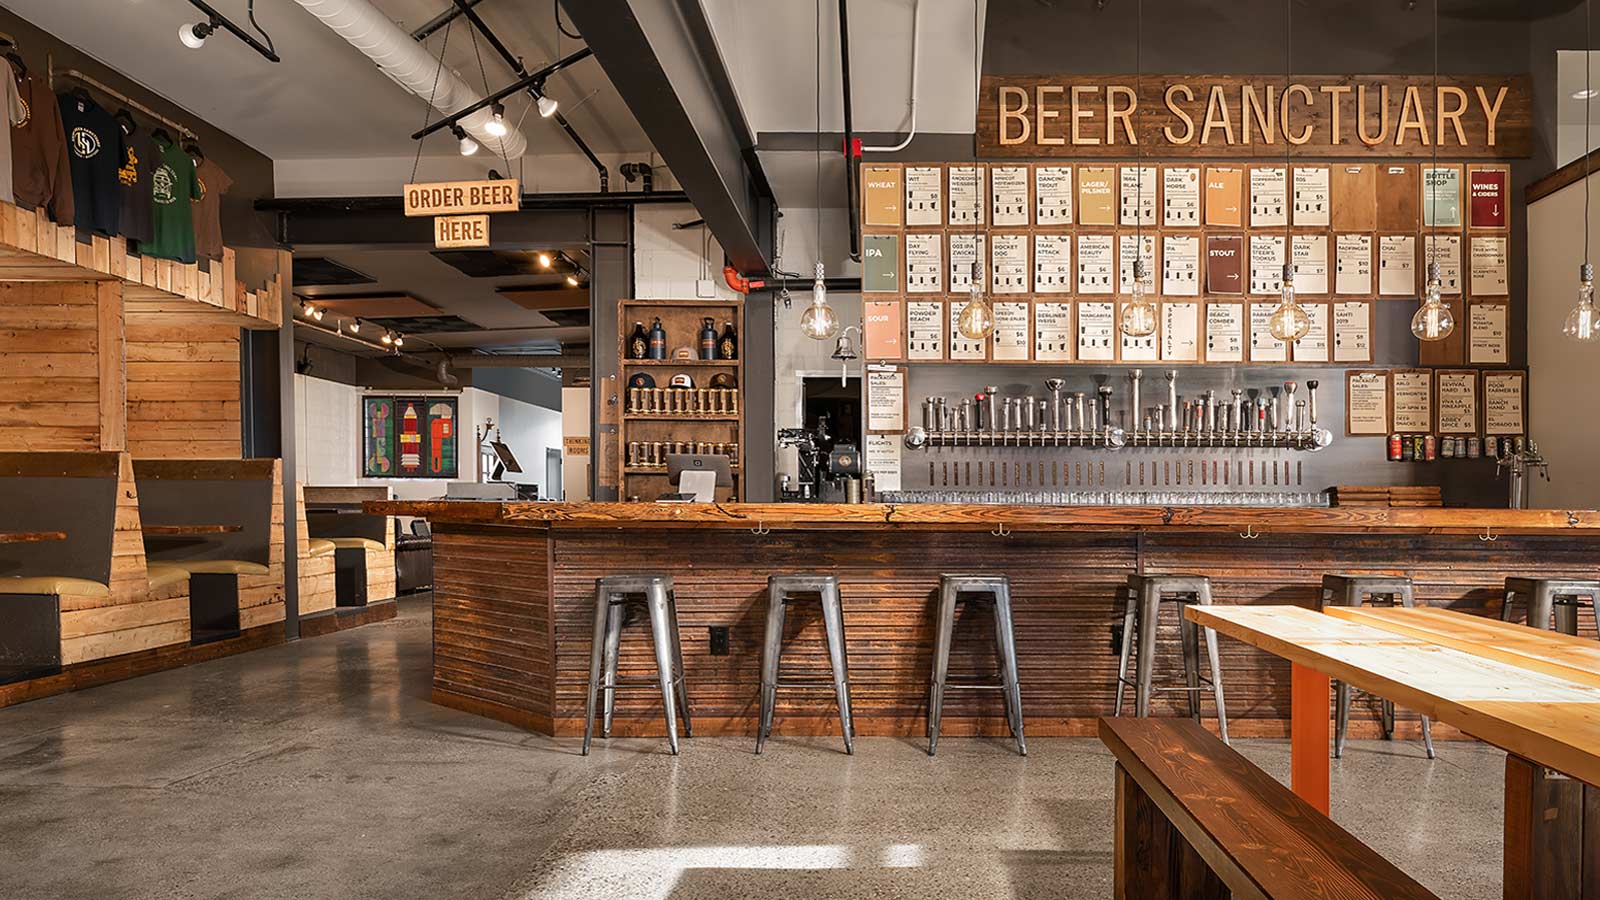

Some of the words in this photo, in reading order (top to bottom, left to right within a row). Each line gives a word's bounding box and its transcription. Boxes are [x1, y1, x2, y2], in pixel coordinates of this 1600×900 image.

[998, 85, 1139, 145] BEER
[1162, 83, 1509, 146] SANCTUARY
[408, 187, 464, 209] ORDER
[469, 185, 514, 206] BEER
[439, 220, 483, 241] HERE
[865, 249, 883, 257] IPA
[1209, 249, 1235, 257] STOUT
